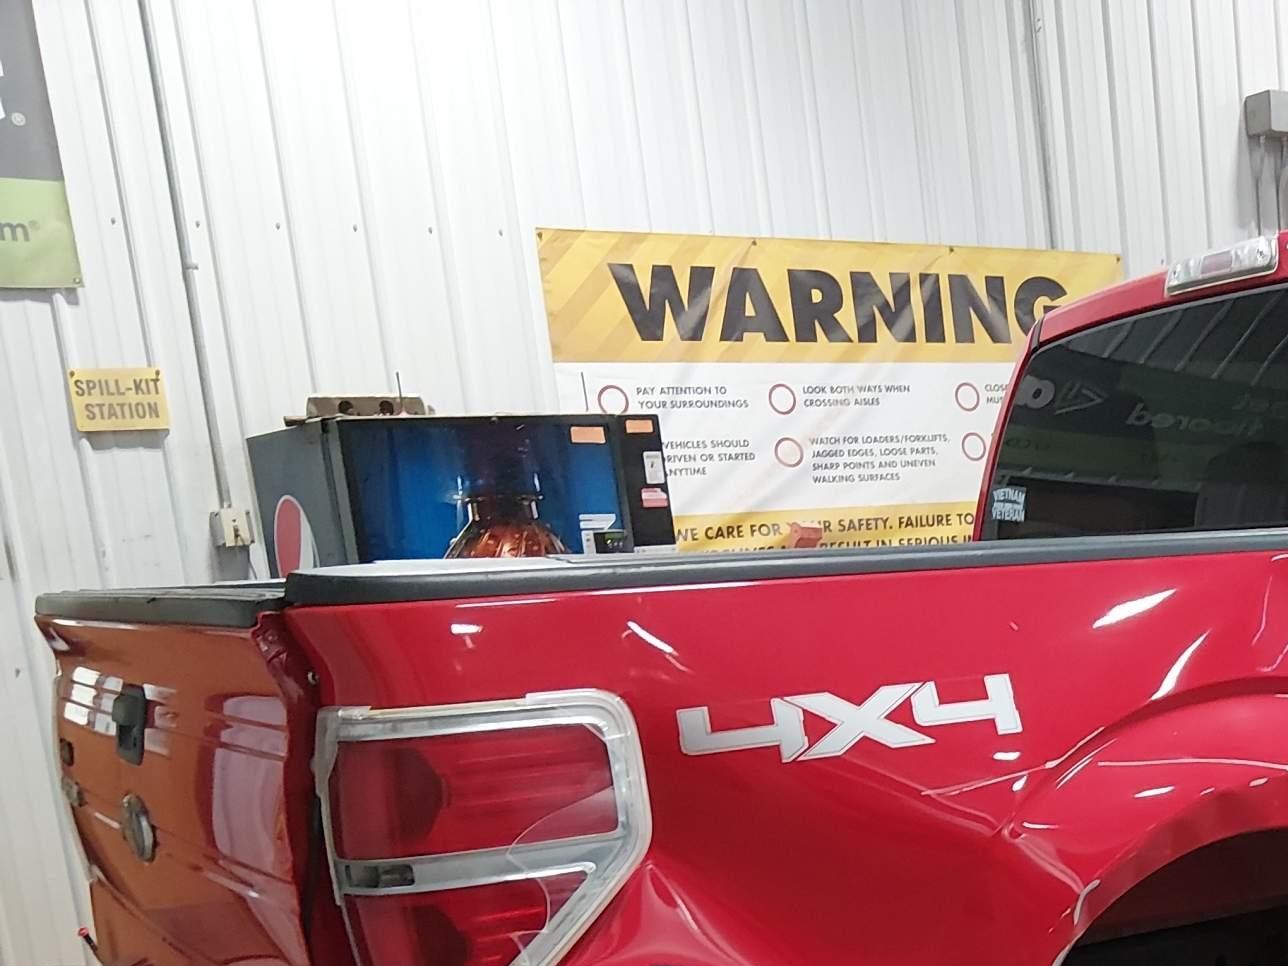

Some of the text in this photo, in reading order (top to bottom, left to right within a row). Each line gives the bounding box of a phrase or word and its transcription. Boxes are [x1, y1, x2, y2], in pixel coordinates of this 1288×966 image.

[608, 263, 1068, 343] WARNING
[74, 378, 160, 397] SPILL-KIT
[636, 386, 727, 396] PAY ATTENTION TO
[802, 384, 911, 394] LOOK BOTH WAYS WHEN
[638, 399, 749, 409] YOUR SURROUNDINGS
[803, 397, 881, 407] CROSSING AISLES
[85, 401, 160, 420] STATION
[662, 439, 750, 449] VEHICLES SHOULD
[809, 436, 841, 446] WATCH
[842, 436, 859, 445] FOR
[665, 452, 756, 463] RIVEN OR STARTED
[812, 449, 845, 459] JAGGED
[879, 447, 908, 457] LOOSE
[812, 459, 936, 472] SHARP POINTS AND UNEVEN
[668, 467, 707, 477] NYTIME
[812, 472, 900, 484] WALKING SURFACES
[992, 487, 1026, 505] VIETNAM
[992, 508, 1025, 523] VETERAN
[677, 528, 699, 541] WE
[704, 525, 745, 540] CARE
[750, 523, 783, 537] FOR
[838, 517, 893, 533] SAFETY.
[898, 513, 952, 529] FAILURE
[956, 512, 975, 526] TO
